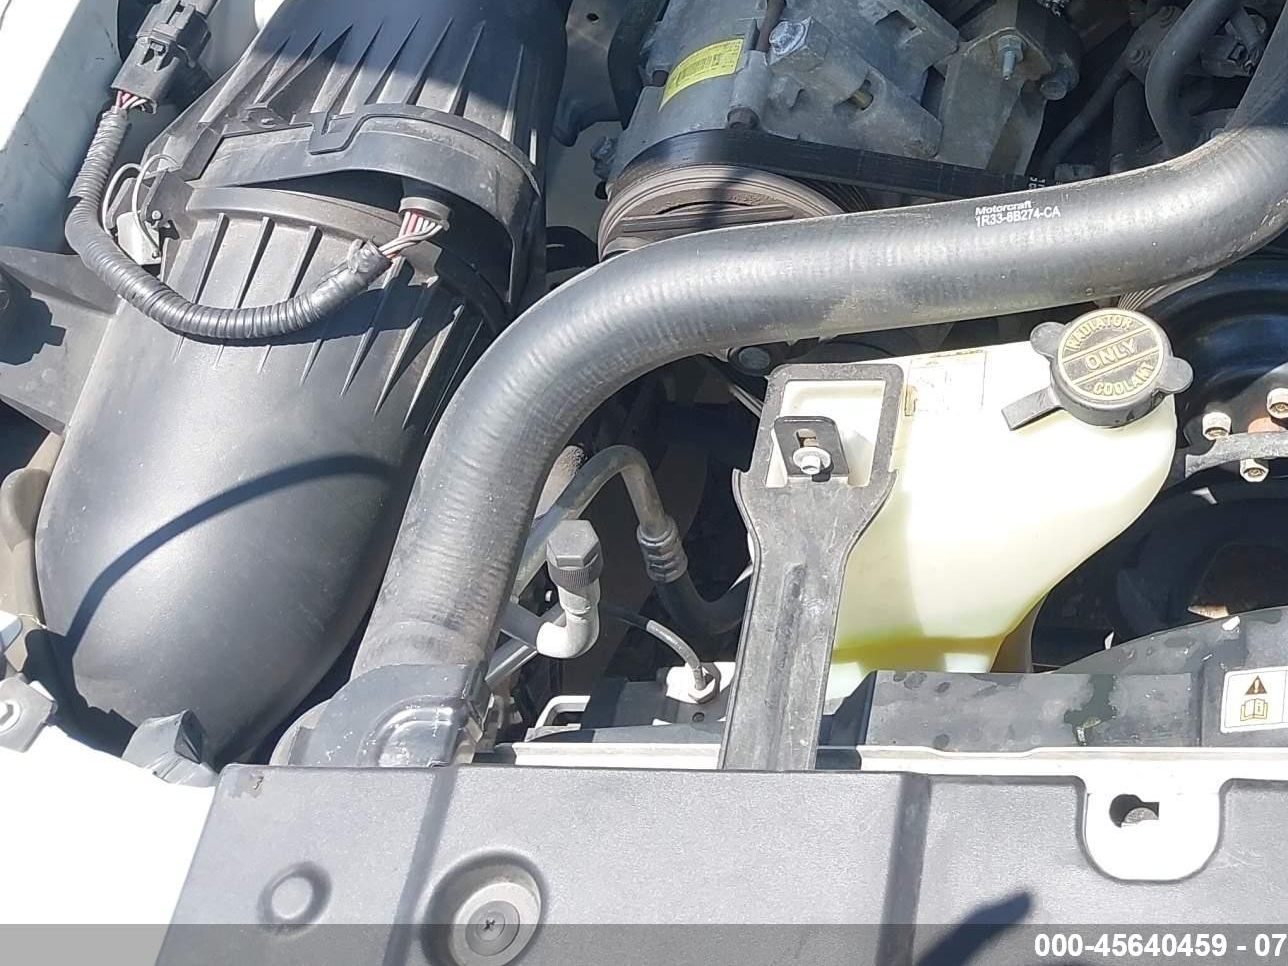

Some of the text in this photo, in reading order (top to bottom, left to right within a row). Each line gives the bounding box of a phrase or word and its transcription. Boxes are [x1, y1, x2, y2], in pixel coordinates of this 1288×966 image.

[974, 200, 1032, 216] Motorcraft
[974, 205, 1061, 228] 1R33-8B274-CA
[1064, 314, 1133, 352] RADIATOR
[1085, 338, 1138, 371] ONLY
[1093, 361, 1155, 396] COOLANT
